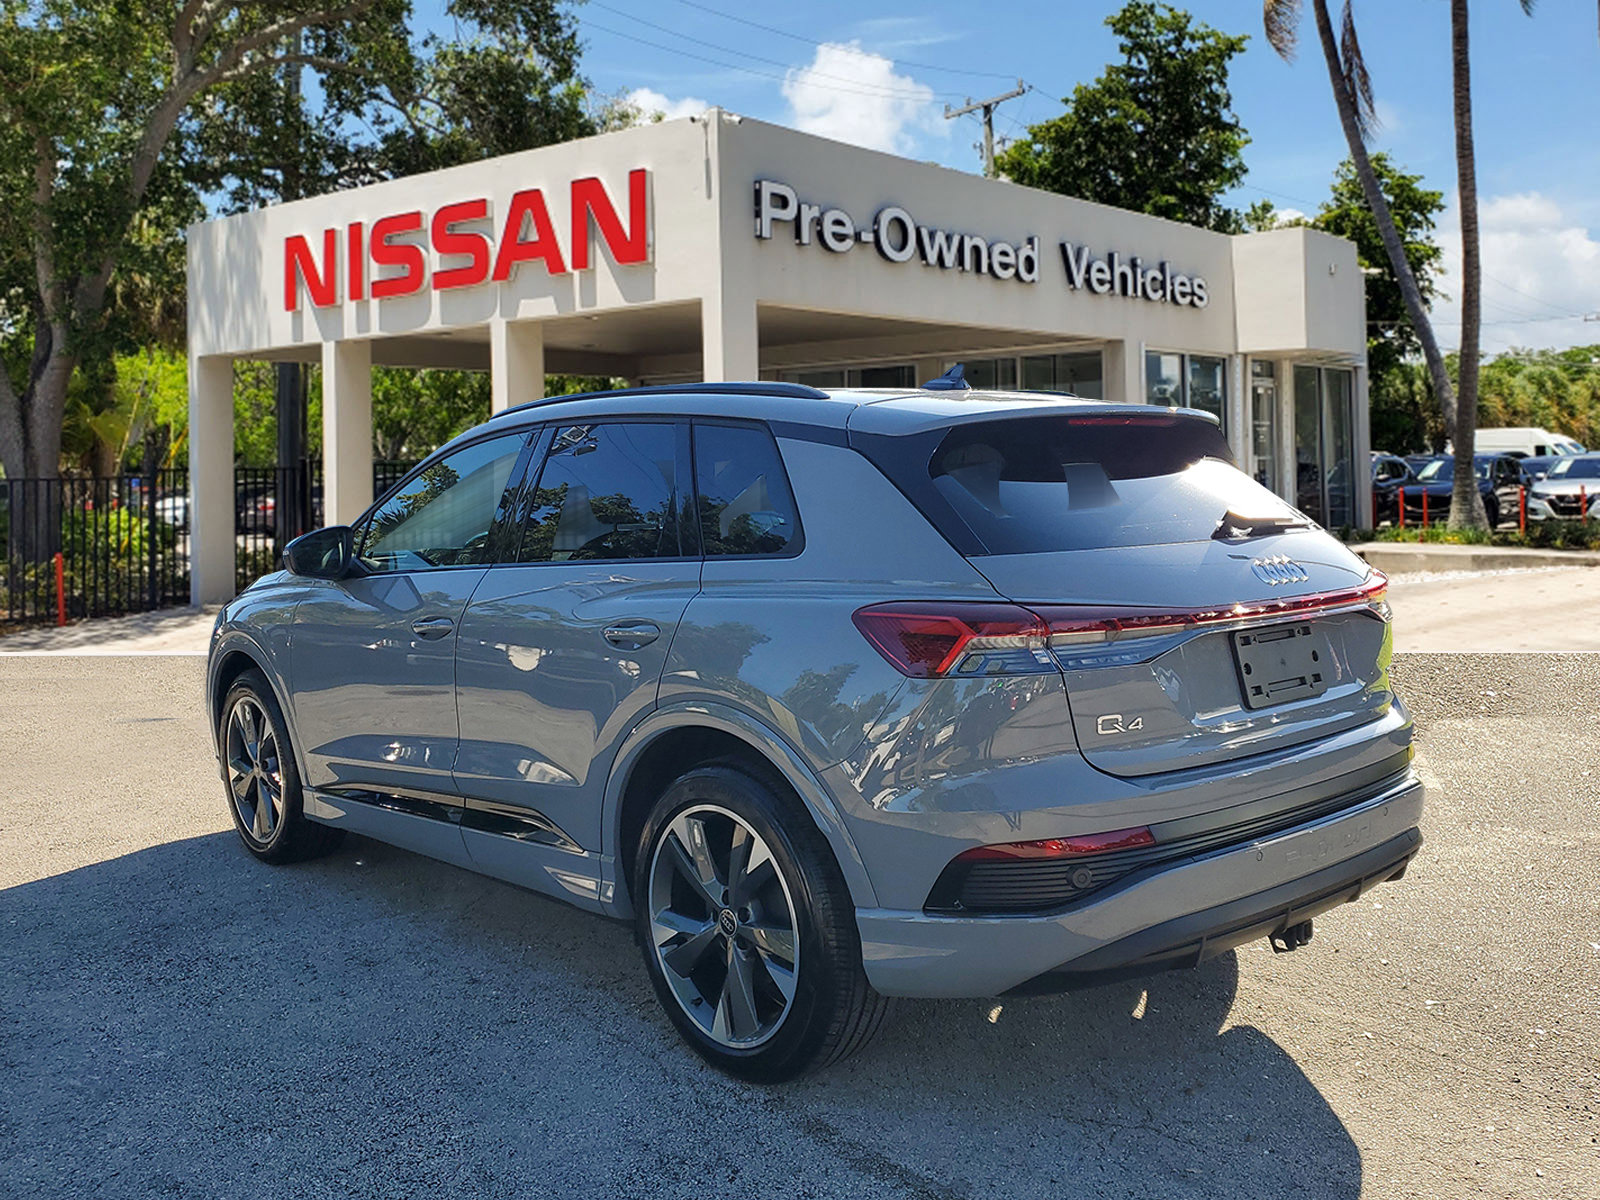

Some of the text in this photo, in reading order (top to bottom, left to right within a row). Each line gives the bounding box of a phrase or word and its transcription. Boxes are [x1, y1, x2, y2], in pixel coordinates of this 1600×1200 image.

[285, 168, 647, 311] NISSAN
[754, 180, 1208, 308] Pre-Owned Vehicles
[1097, 714, 1144, 735] Q4
